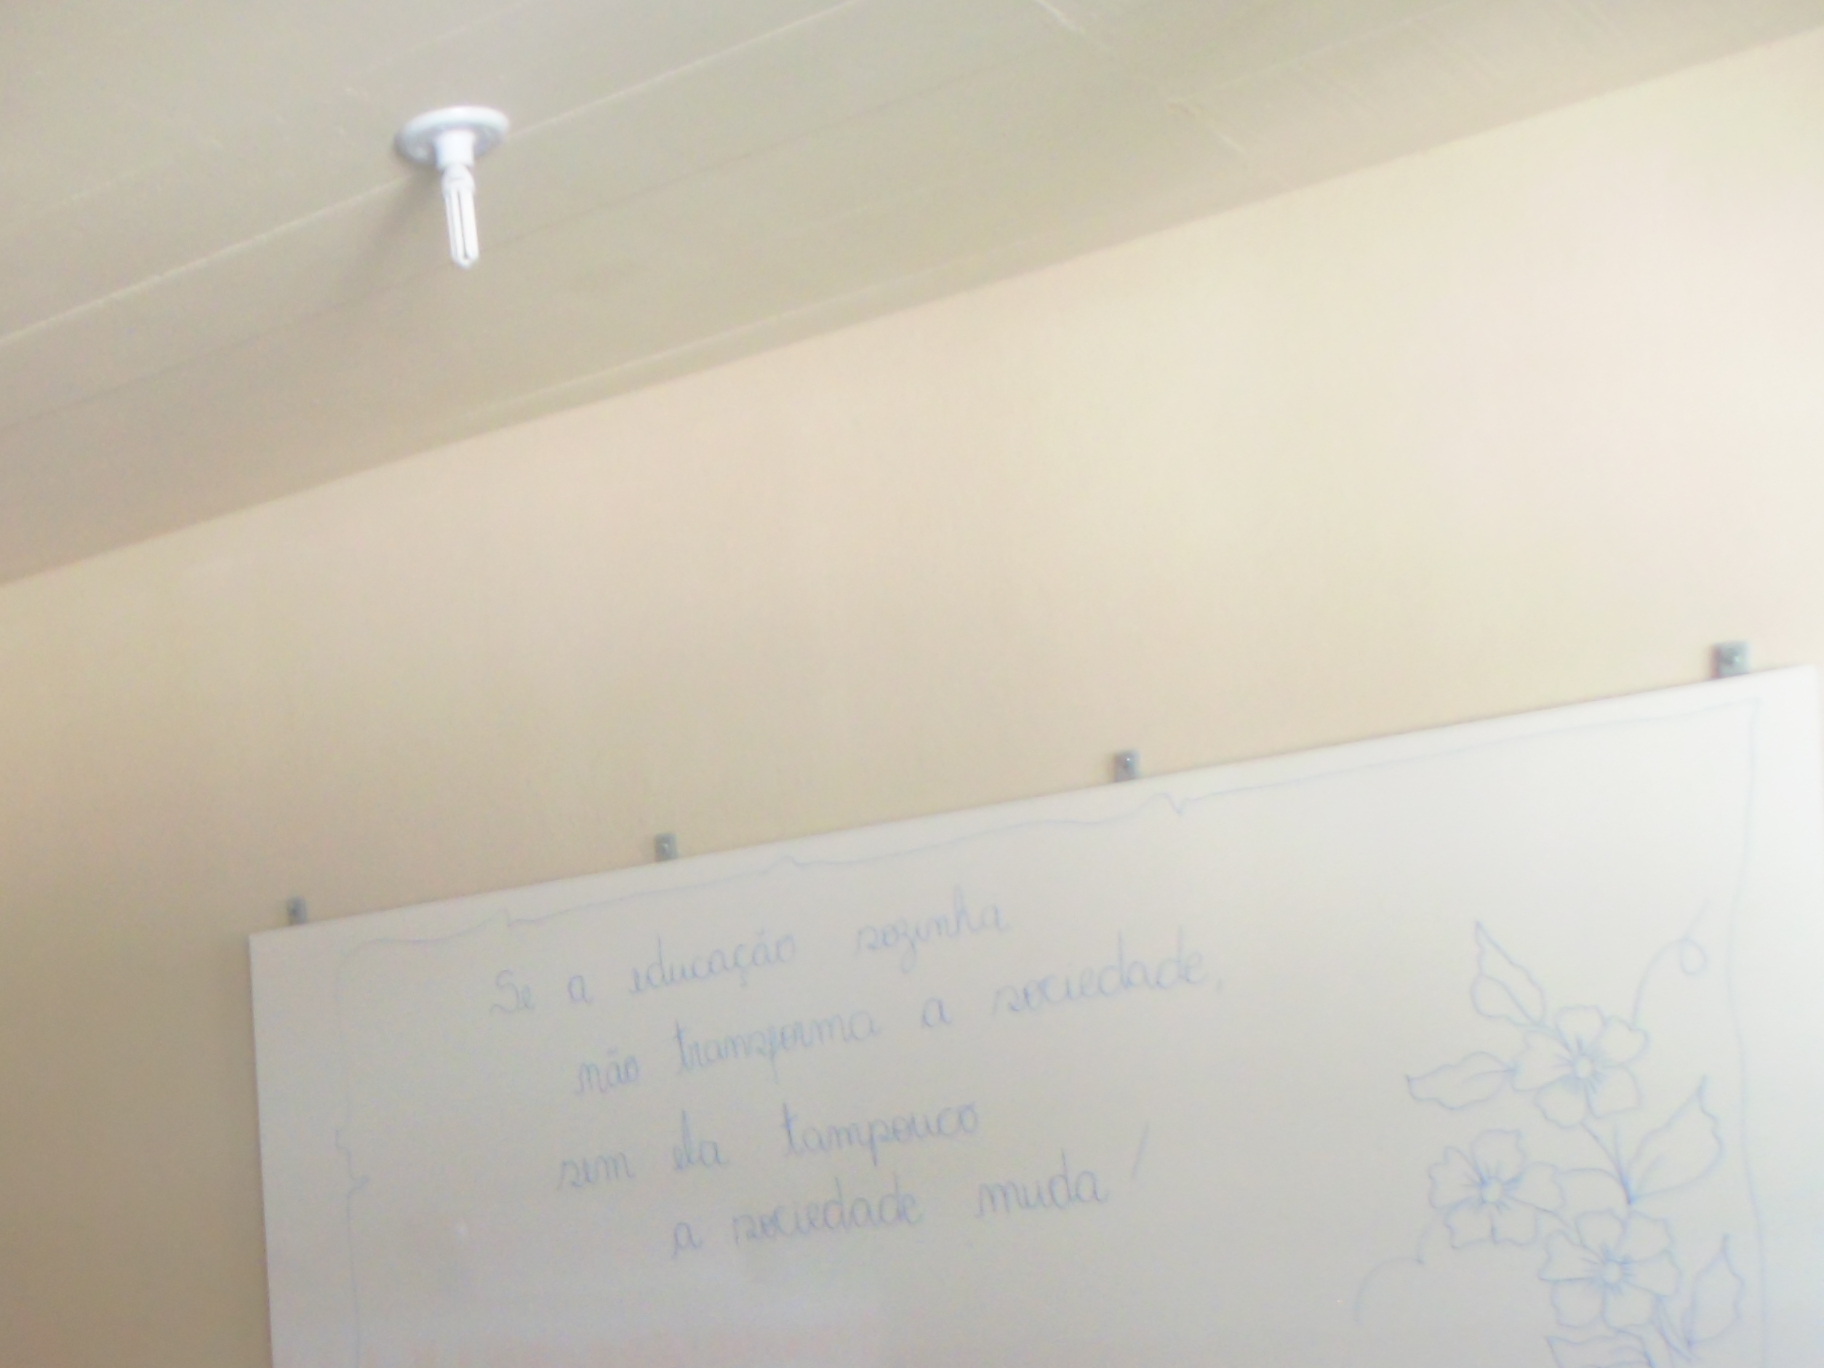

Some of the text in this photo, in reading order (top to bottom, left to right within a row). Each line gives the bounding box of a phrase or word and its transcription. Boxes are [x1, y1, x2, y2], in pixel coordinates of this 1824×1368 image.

[489, 884, 1011, 1014] Se a educação sozinha
[576, 1047, 640, 1094] não
[921, 996, 953, 1029] a
[556, 1101, 981, 1192] sem ela tampouco
[671, 1219, 704, 1257] a
[733, 1175, 926, 1246] sociedade
